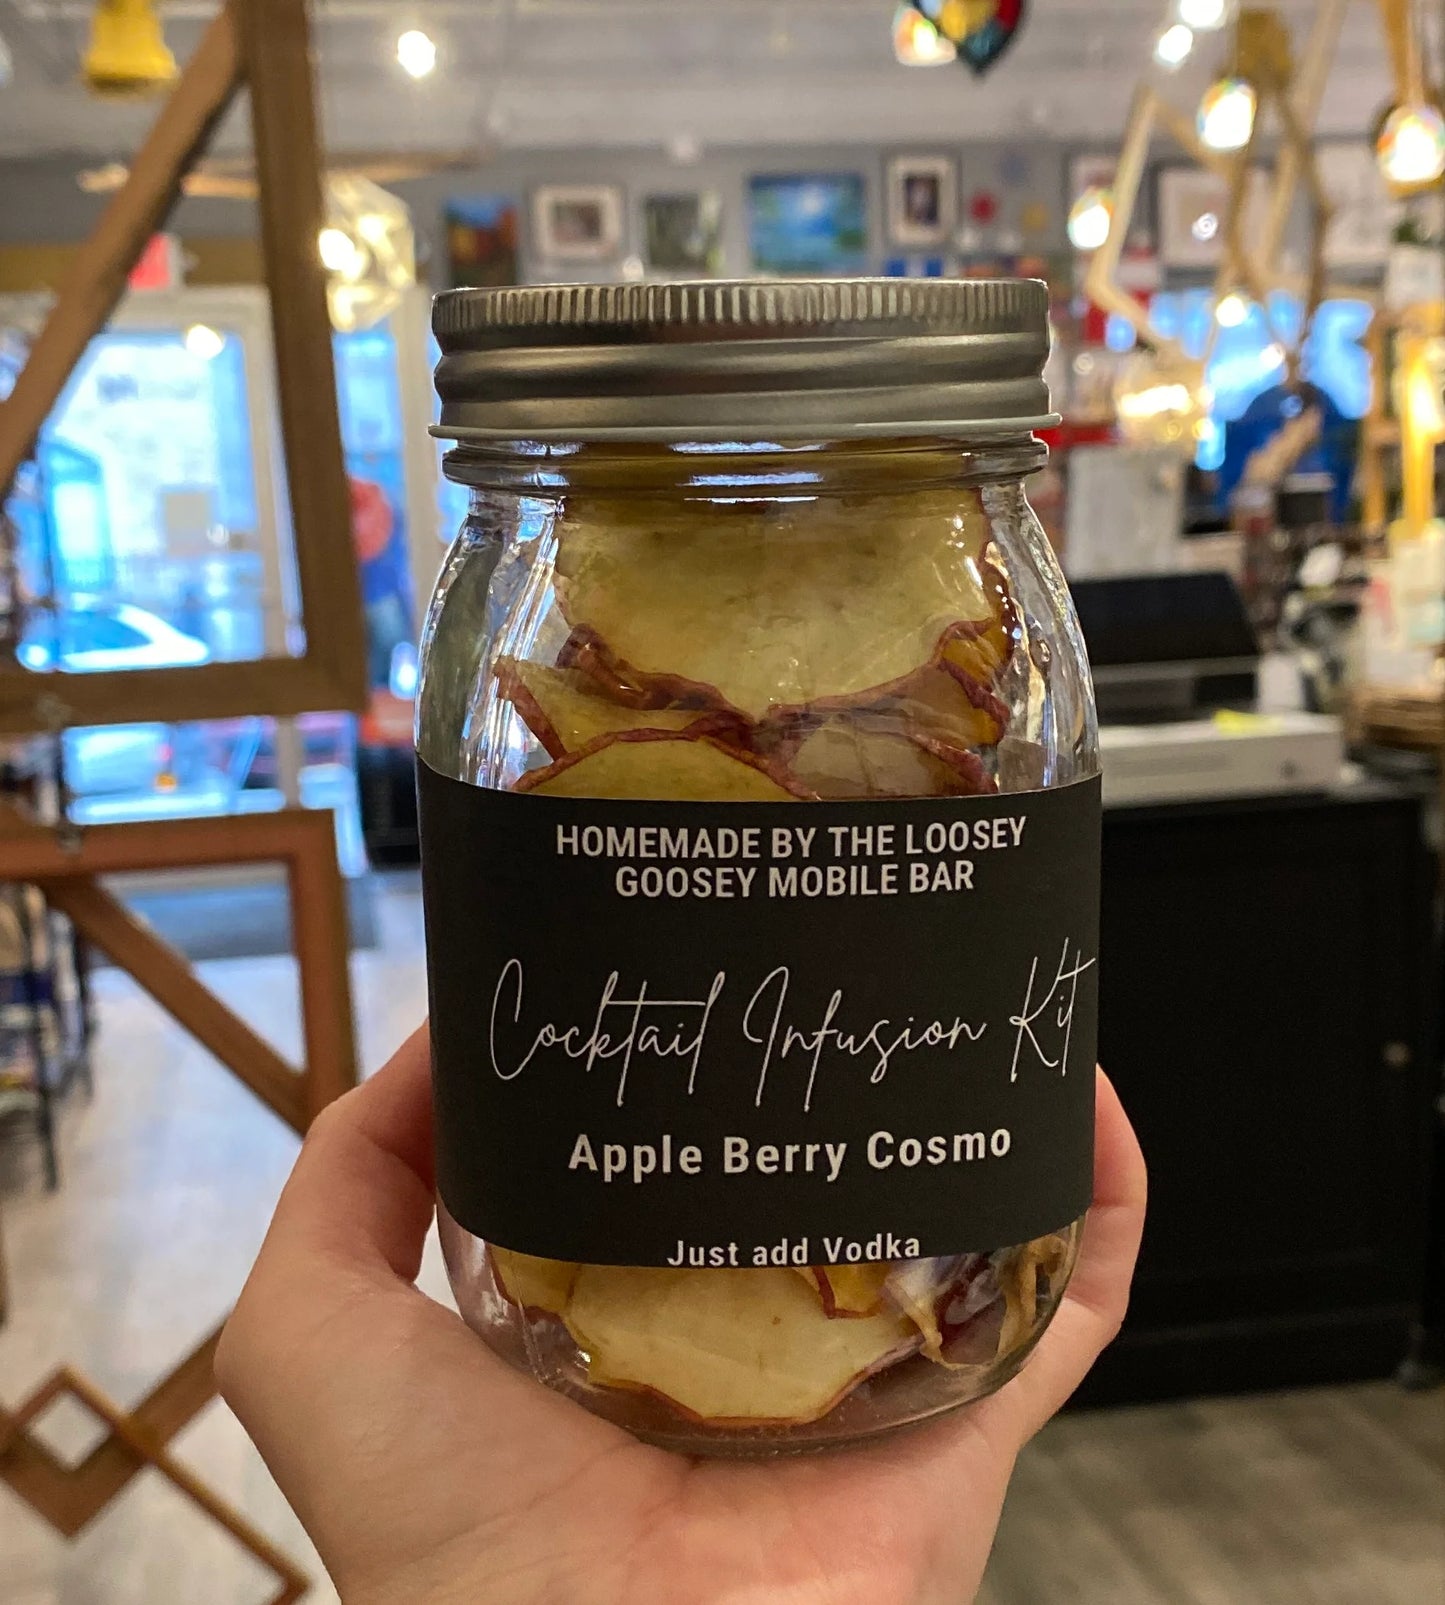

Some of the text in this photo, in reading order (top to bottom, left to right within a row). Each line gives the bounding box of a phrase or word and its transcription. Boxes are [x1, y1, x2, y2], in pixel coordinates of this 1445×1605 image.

[557, 815, 1027, 859] HOMEMADE BY THE LOOSEY
[616, 860, 974, 898] GOOSEY MOBILE BAR
[490, 936, 1097, 1112] Cocktail Infusion Kit
[568, 1128, 1011, 1184] Apple Berry Cosmo
[667, 1232, 920, 1266] Just add Vodka
